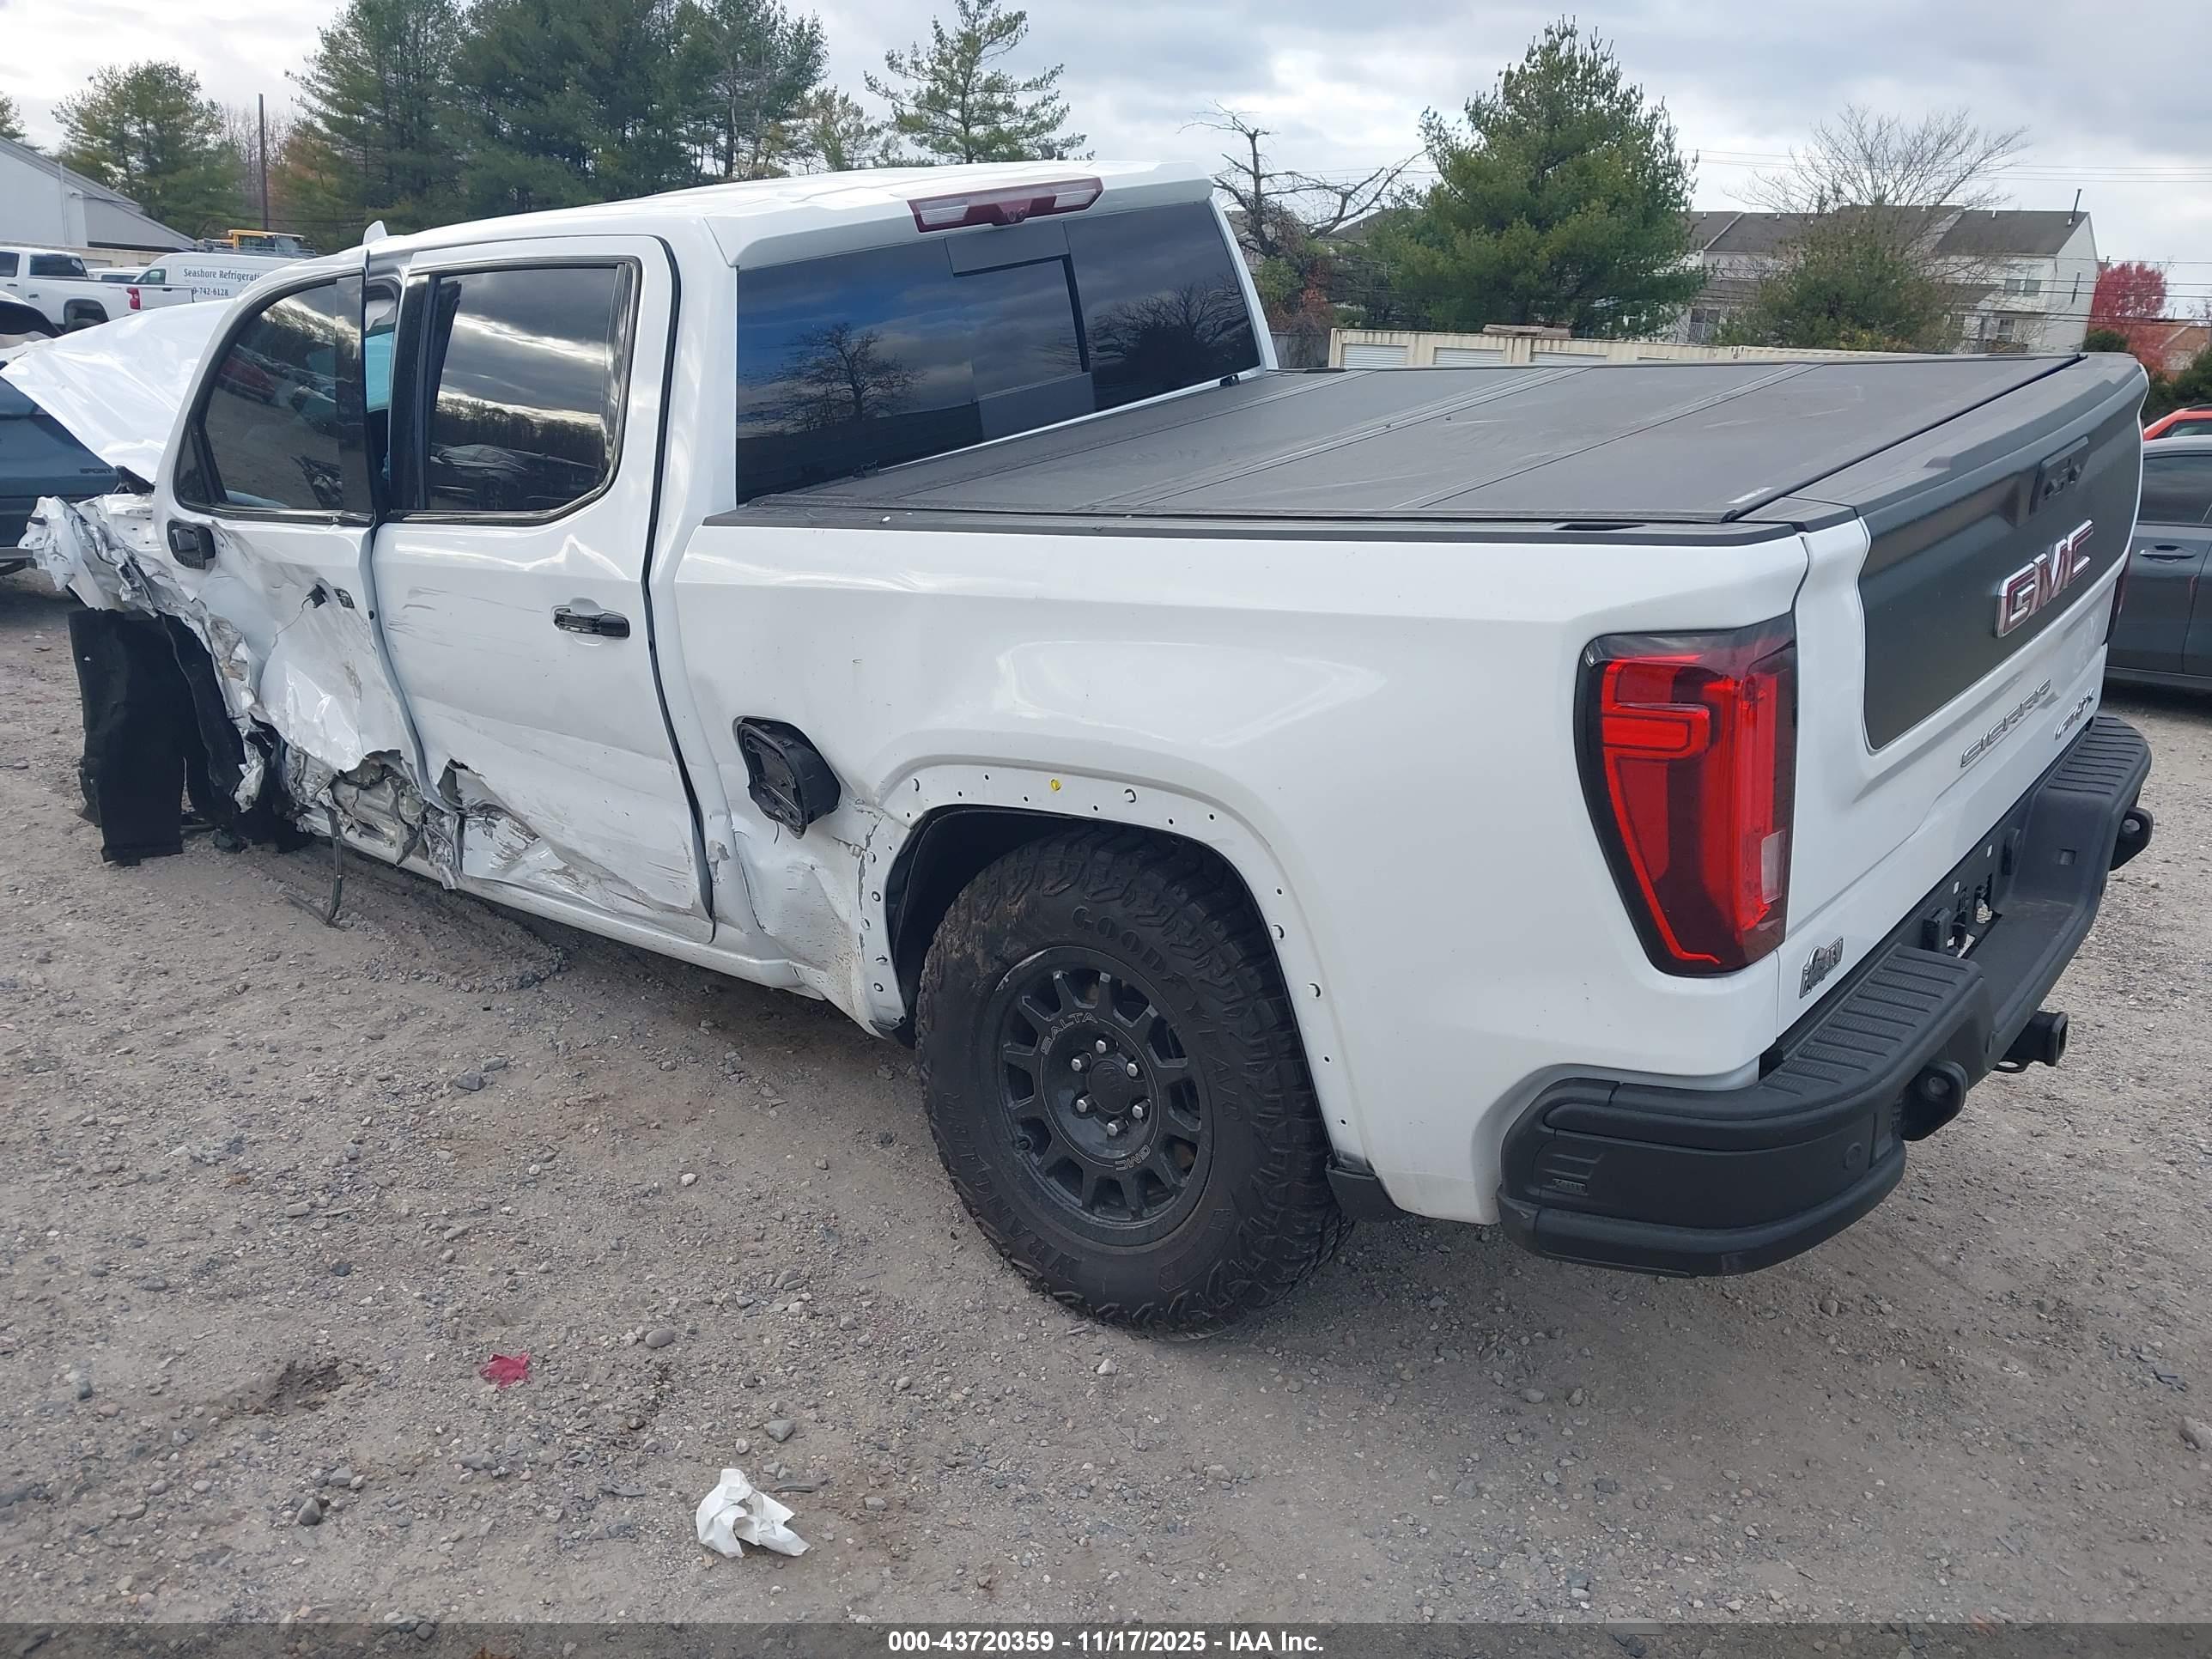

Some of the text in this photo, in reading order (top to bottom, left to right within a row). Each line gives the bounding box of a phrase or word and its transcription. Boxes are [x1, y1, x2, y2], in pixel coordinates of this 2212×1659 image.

[184, 268, 216, 278] Seashore
[1995, 520, 2094, 638] GMC
[1960, 678, 2051, 767] SIERRA
[1041, 1012, 1098, 1054] SALTA
[1115, 1145, 1151, 1170] GMC
